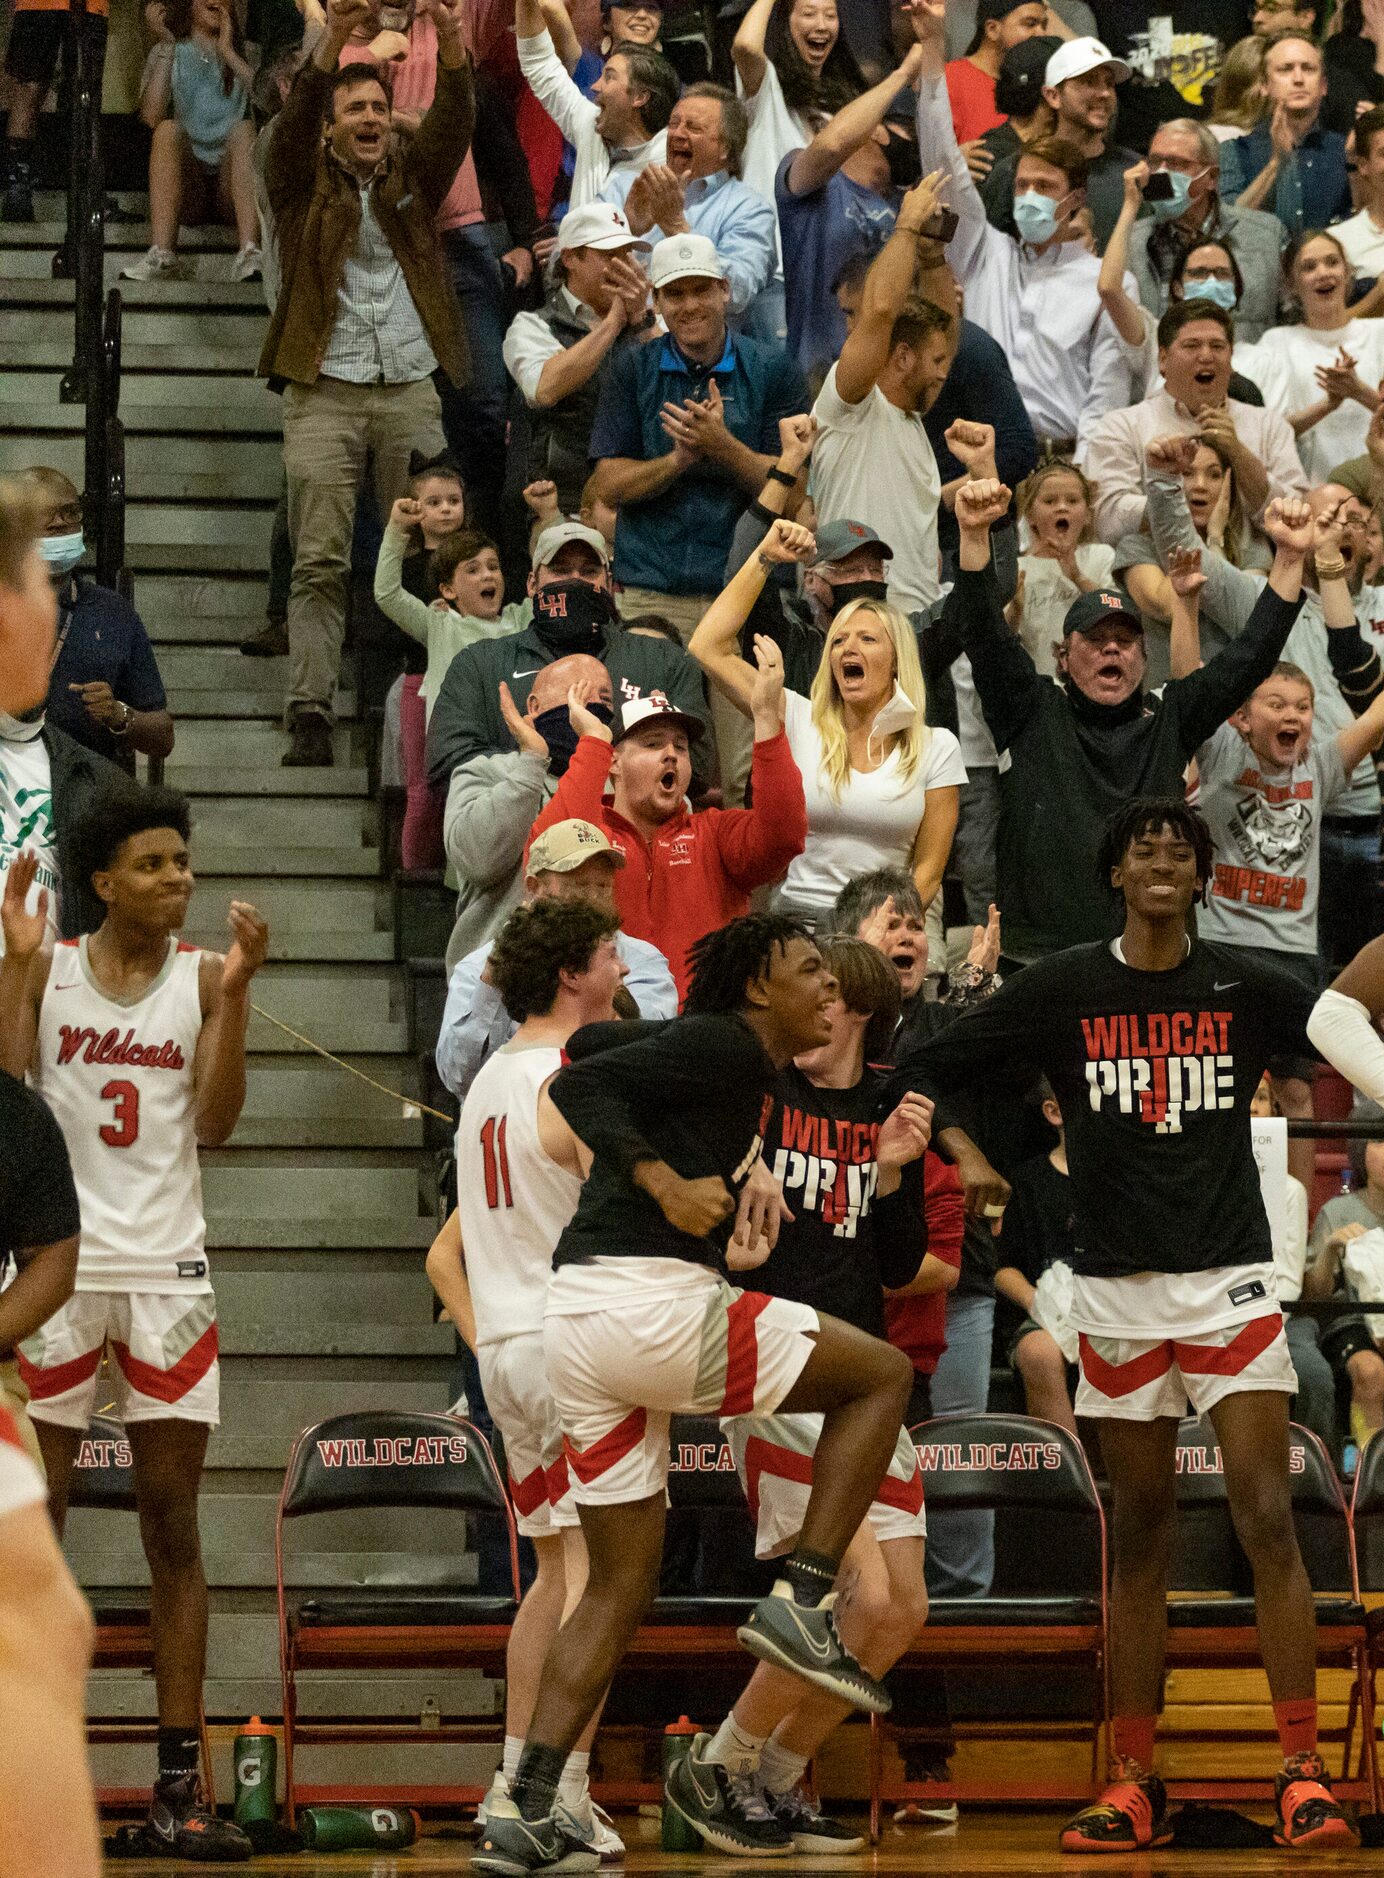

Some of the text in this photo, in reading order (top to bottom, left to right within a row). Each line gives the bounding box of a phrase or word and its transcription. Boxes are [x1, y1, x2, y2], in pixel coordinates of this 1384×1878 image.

[57, 1025, 184, 1070] Wildcats
[1081, 1012, 1233, 1060] WILDCAT
[1085, 1055, 1235, 1114] PRIDE
[99, 1080, 139, 1147] 3
[480, 1114, 513, 1209] 11
[73, 1440, 132, 1467] ATS
[317, 1437, 467, 1467] WILDCATS
[914, 1443, 1061, 1471] WILDCATS
[238, 1757, 261, 1787] G
[372, 1809, 398, 1832] G
